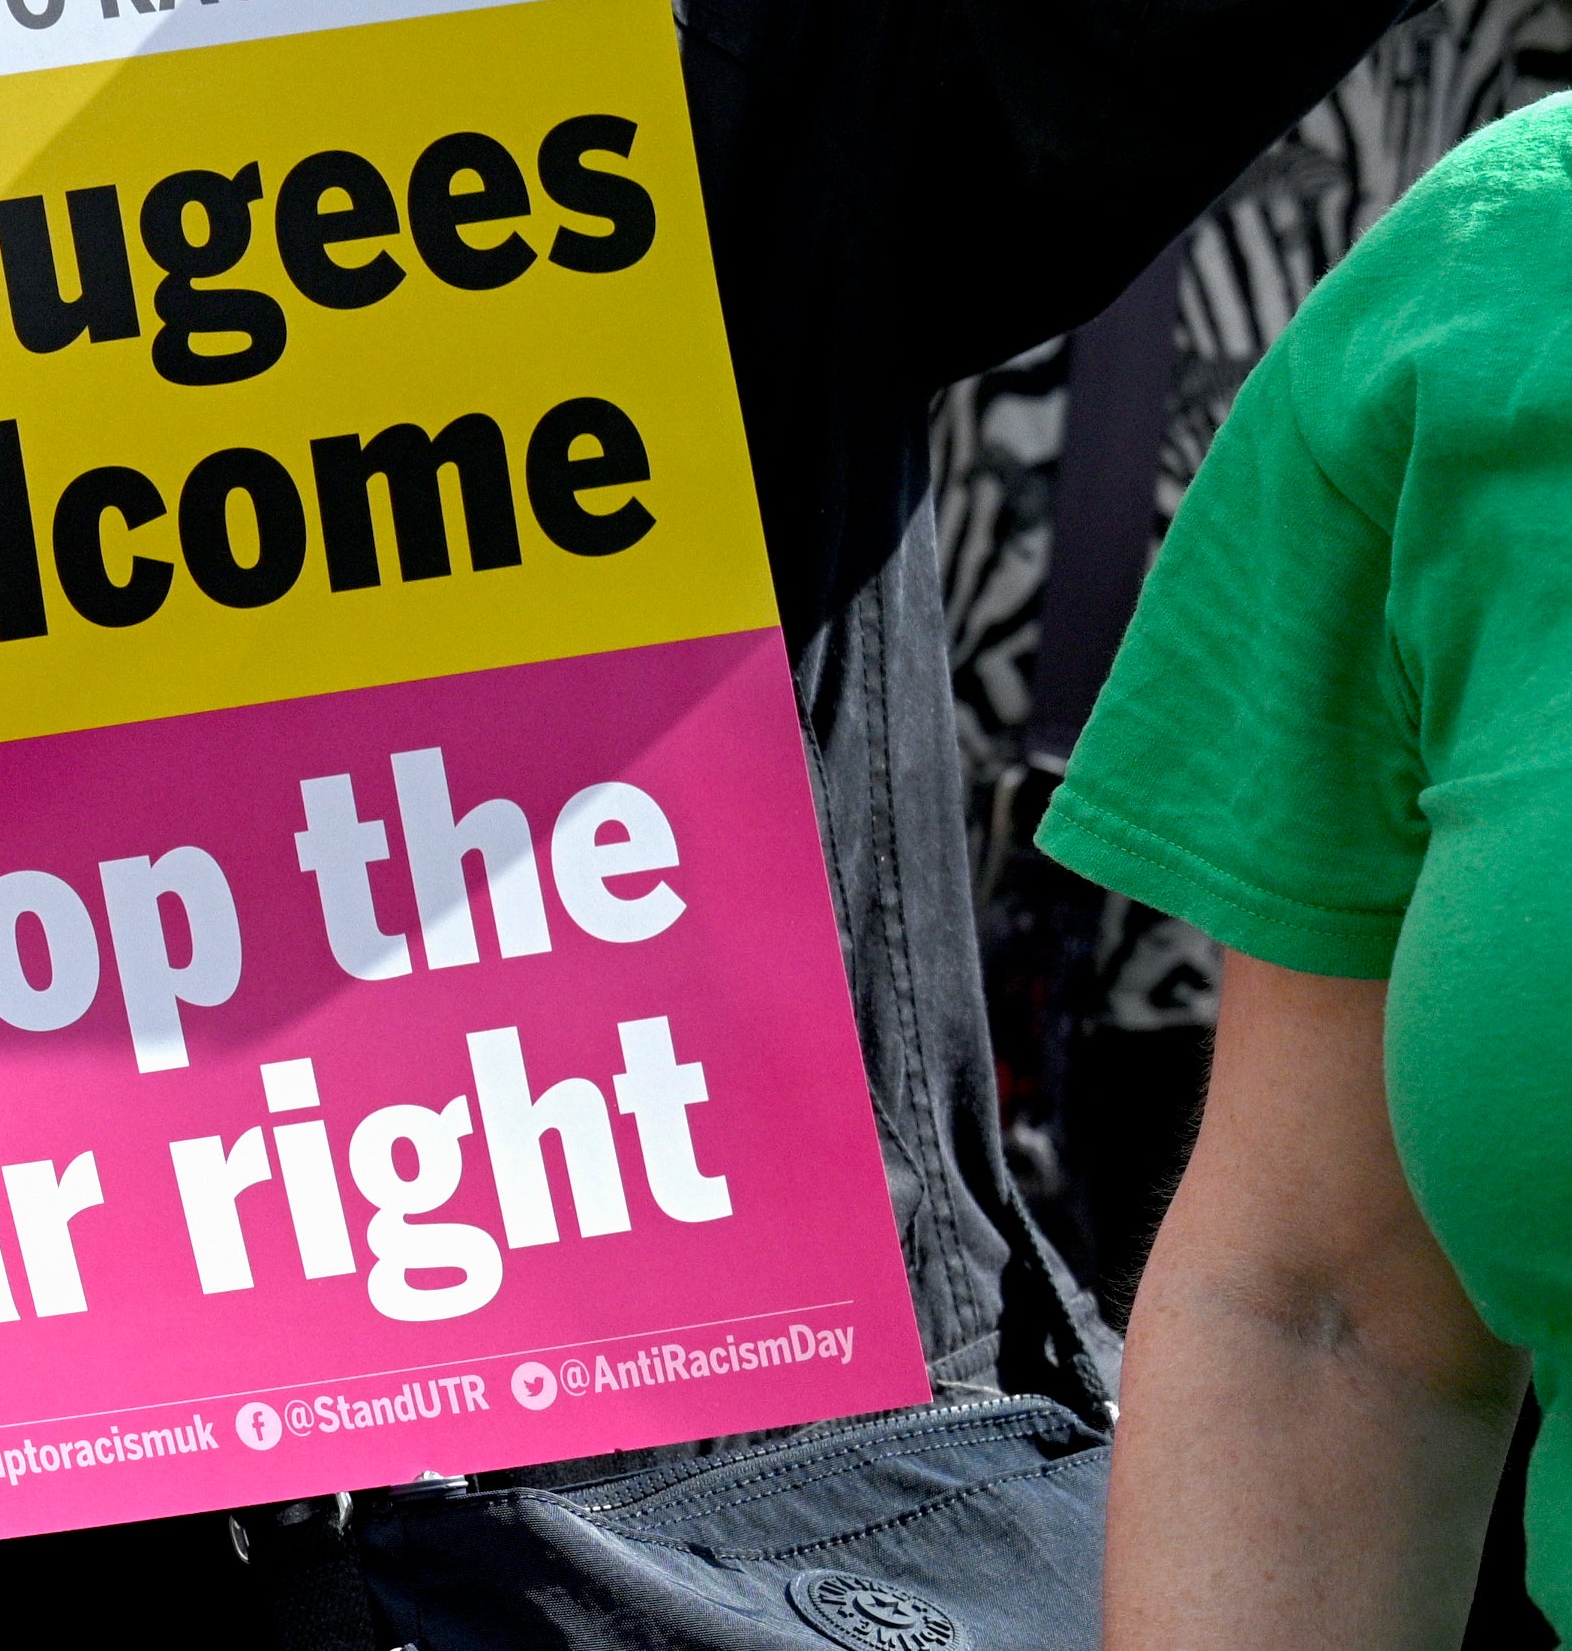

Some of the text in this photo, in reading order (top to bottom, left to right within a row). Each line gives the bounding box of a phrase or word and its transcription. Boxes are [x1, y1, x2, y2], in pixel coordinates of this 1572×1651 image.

[294, 747, 687, 981] the
[169, 1015, 733, 1322] right
[283, 1374, 491, 1436] @StandUTR
[559, 1324, 855, 1397] @AntiRacismDay
